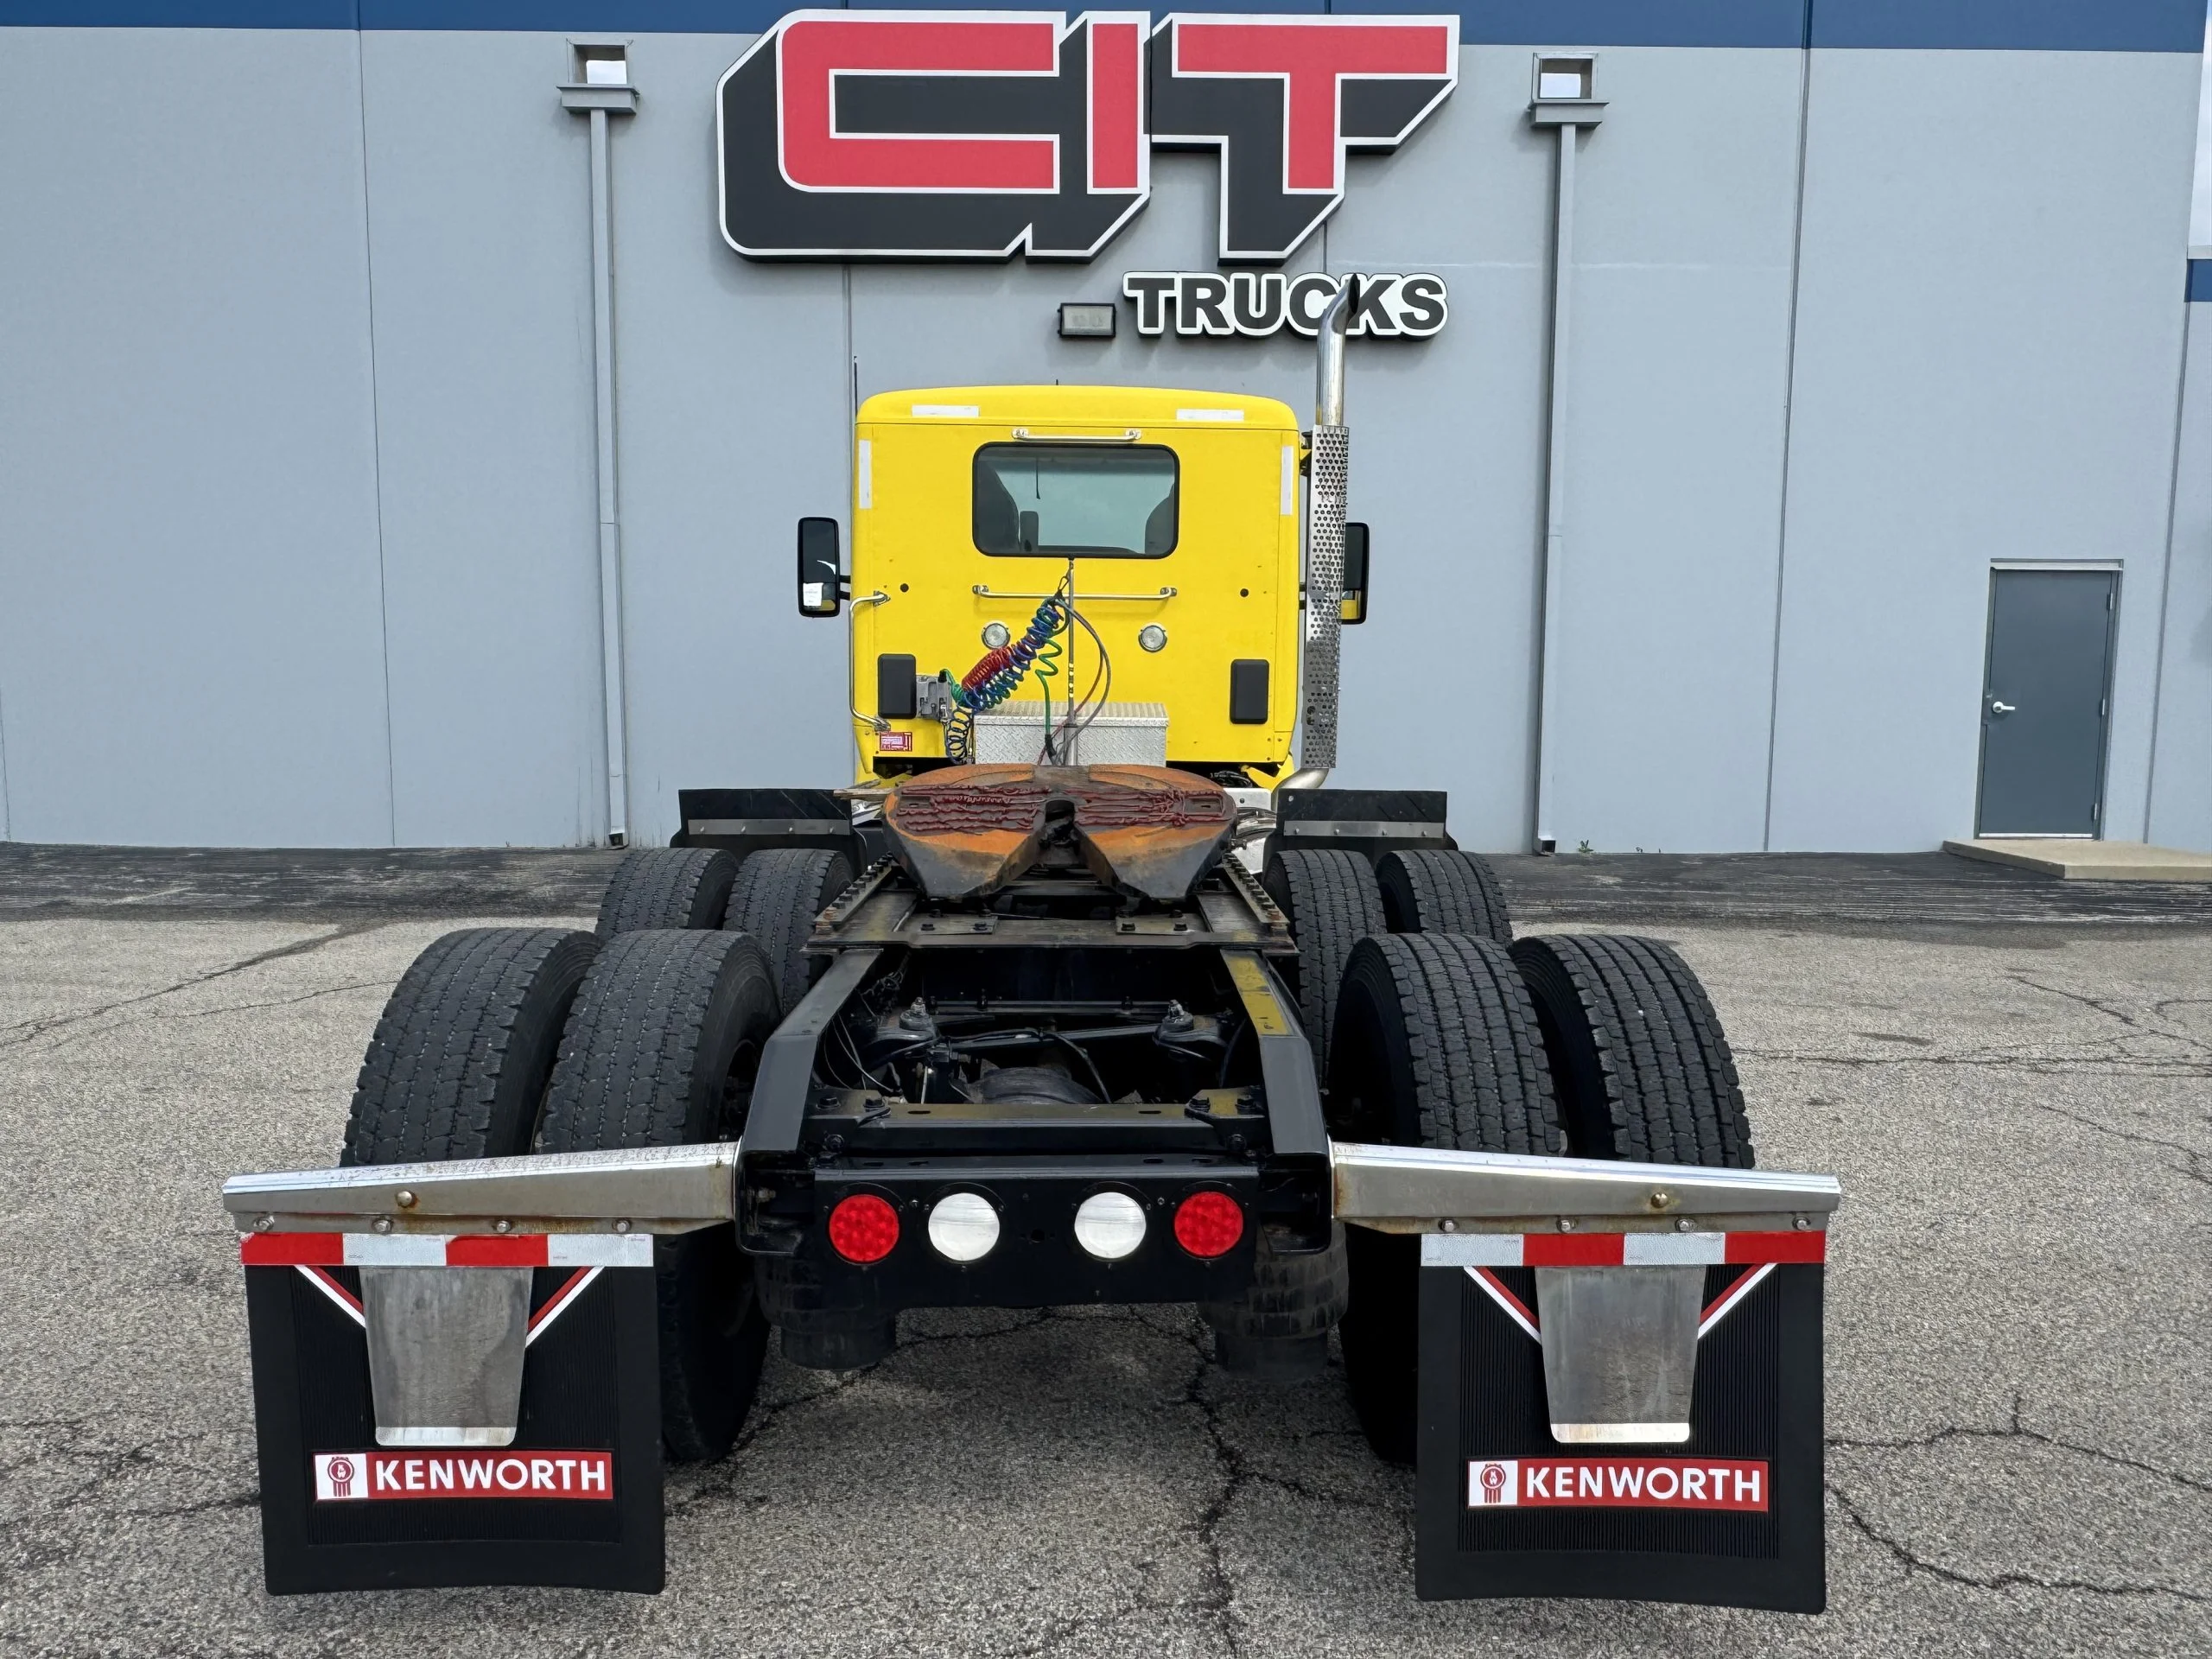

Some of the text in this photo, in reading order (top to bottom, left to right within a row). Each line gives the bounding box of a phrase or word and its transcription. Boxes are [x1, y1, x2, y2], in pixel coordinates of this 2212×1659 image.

[772, 11, 1460, 197] CIT
[1126, 276, 1446, 332] TRUCKS
[375, 1459, 605, 1491] KENWORTH
[1526, 1465, 1761, 1503] KENWORTH
